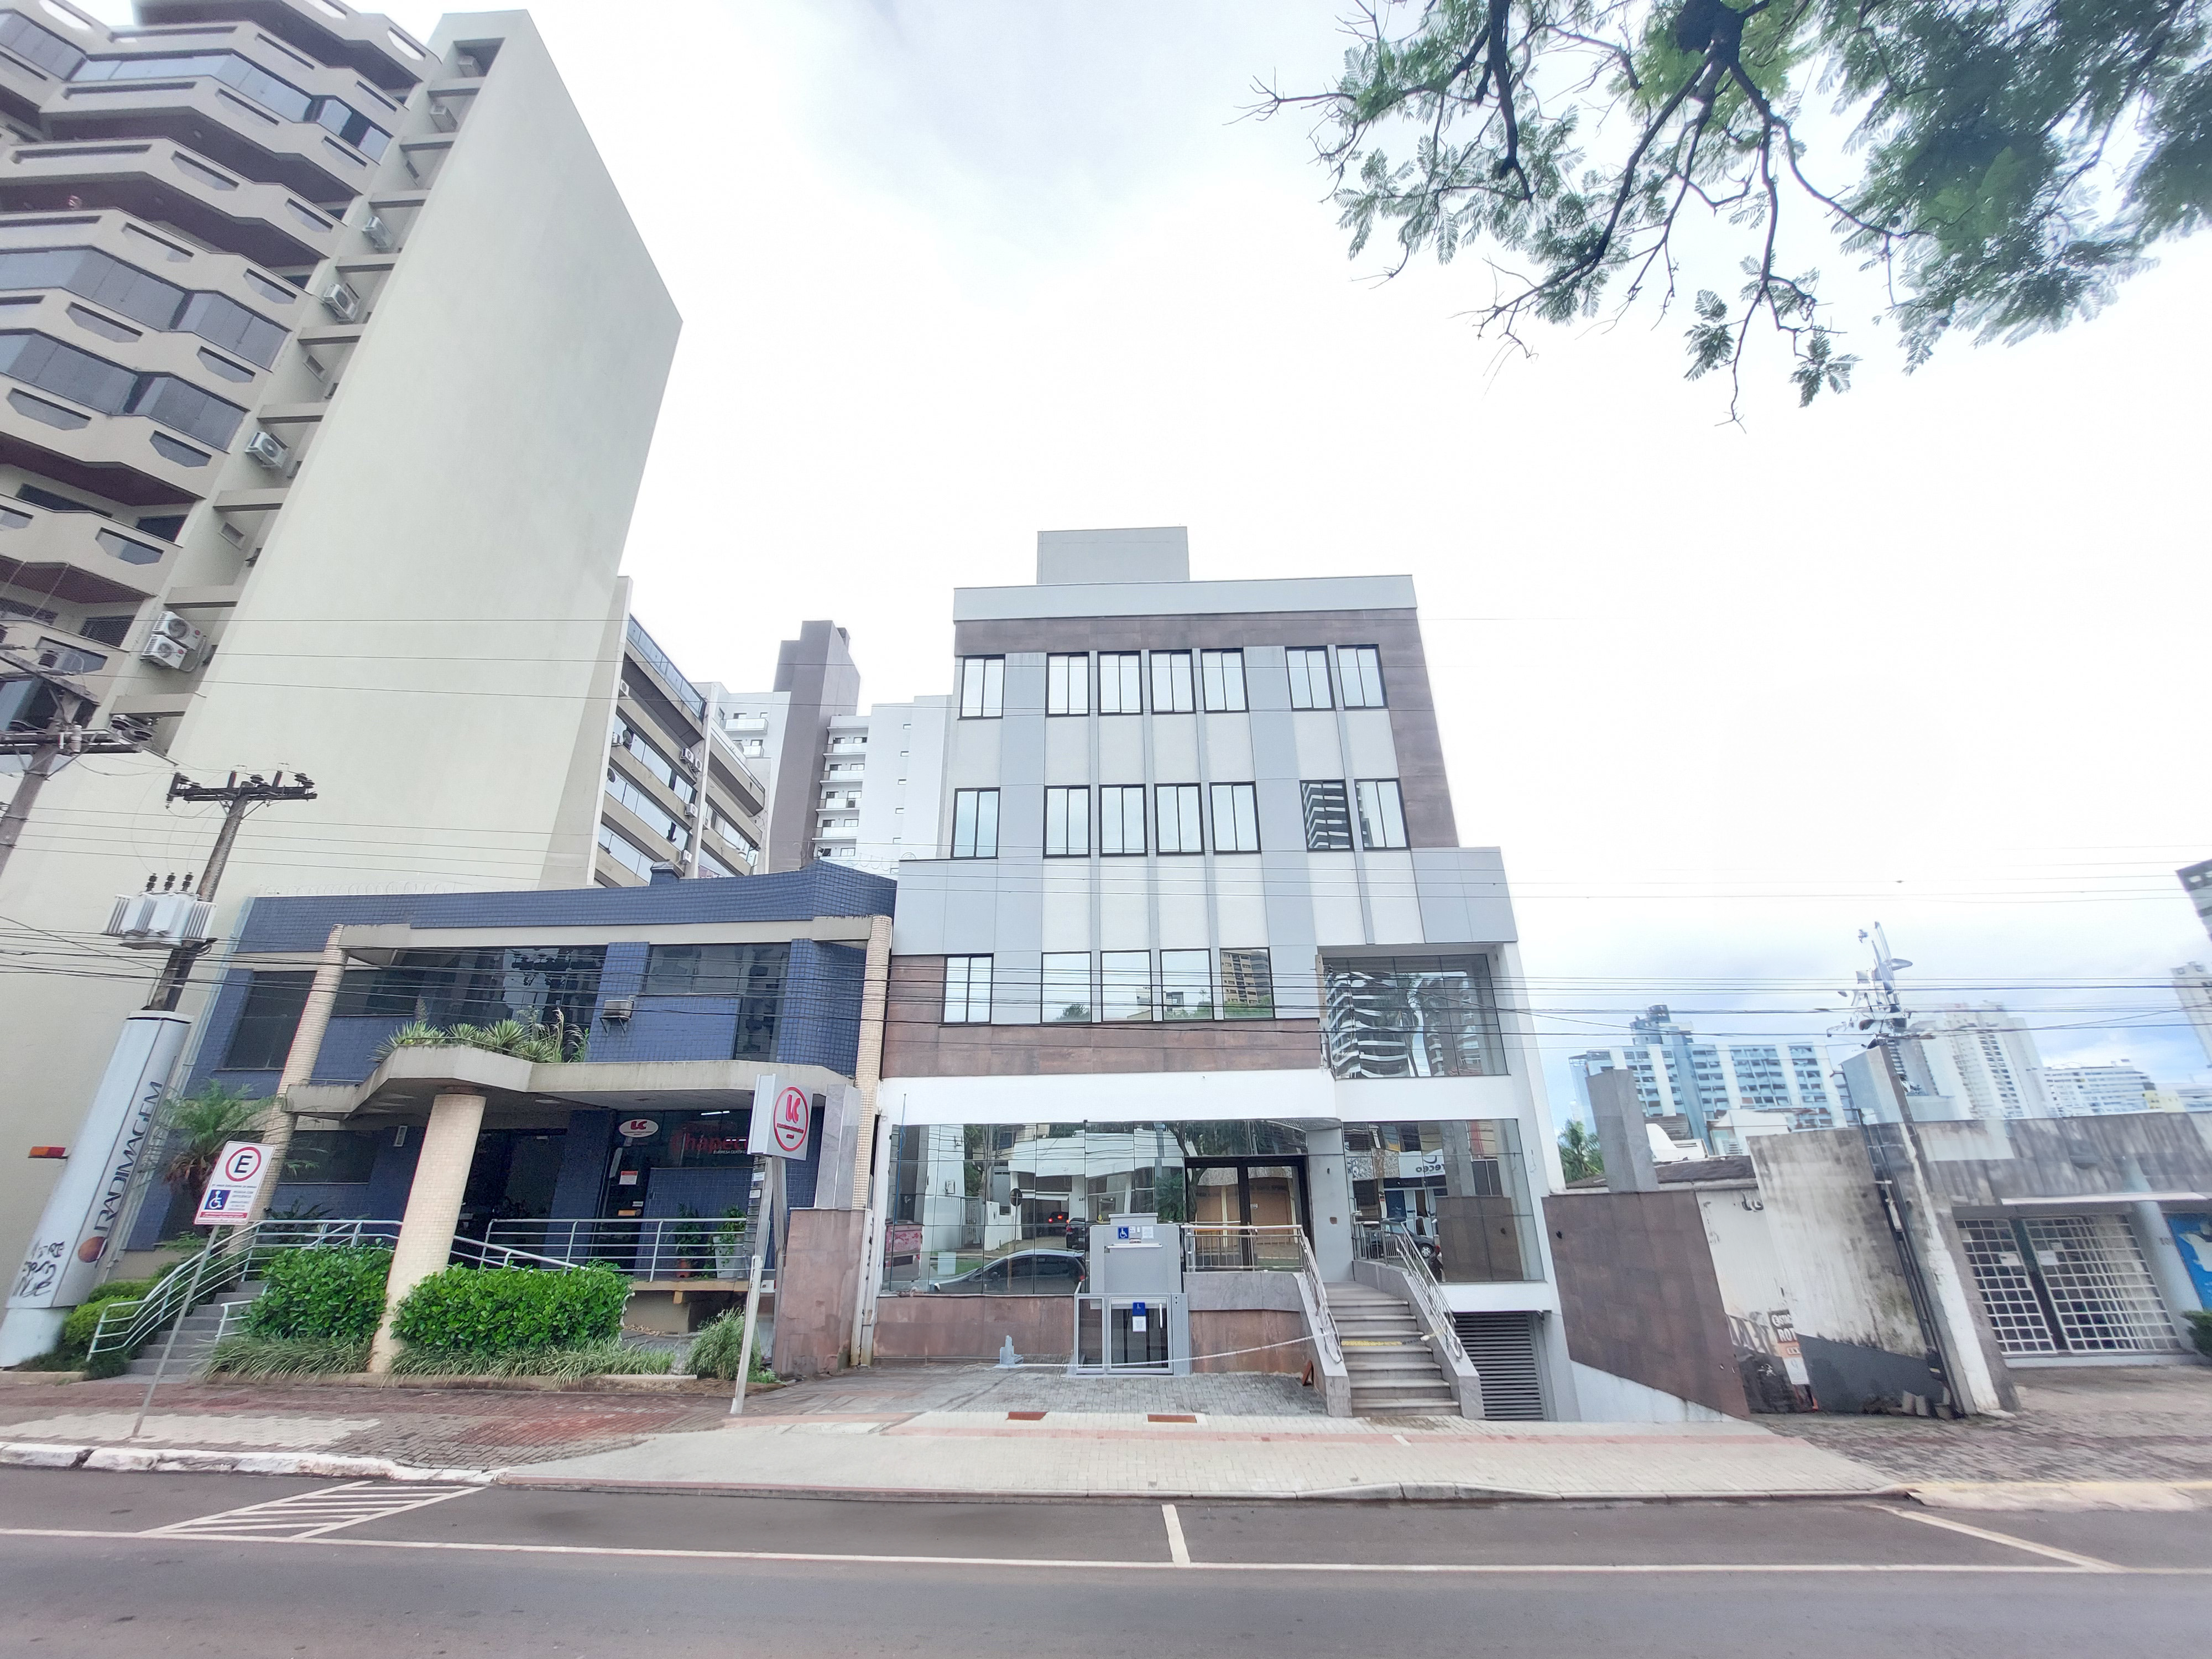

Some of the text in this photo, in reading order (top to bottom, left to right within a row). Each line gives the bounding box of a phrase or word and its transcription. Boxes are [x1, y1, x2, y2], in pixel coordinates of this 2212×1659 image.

[670, 1132, 748, 1155] Chapec
[93, 1081, 163, 1230] RADIMAGEM
[234, 1155, 253, 1173] E
